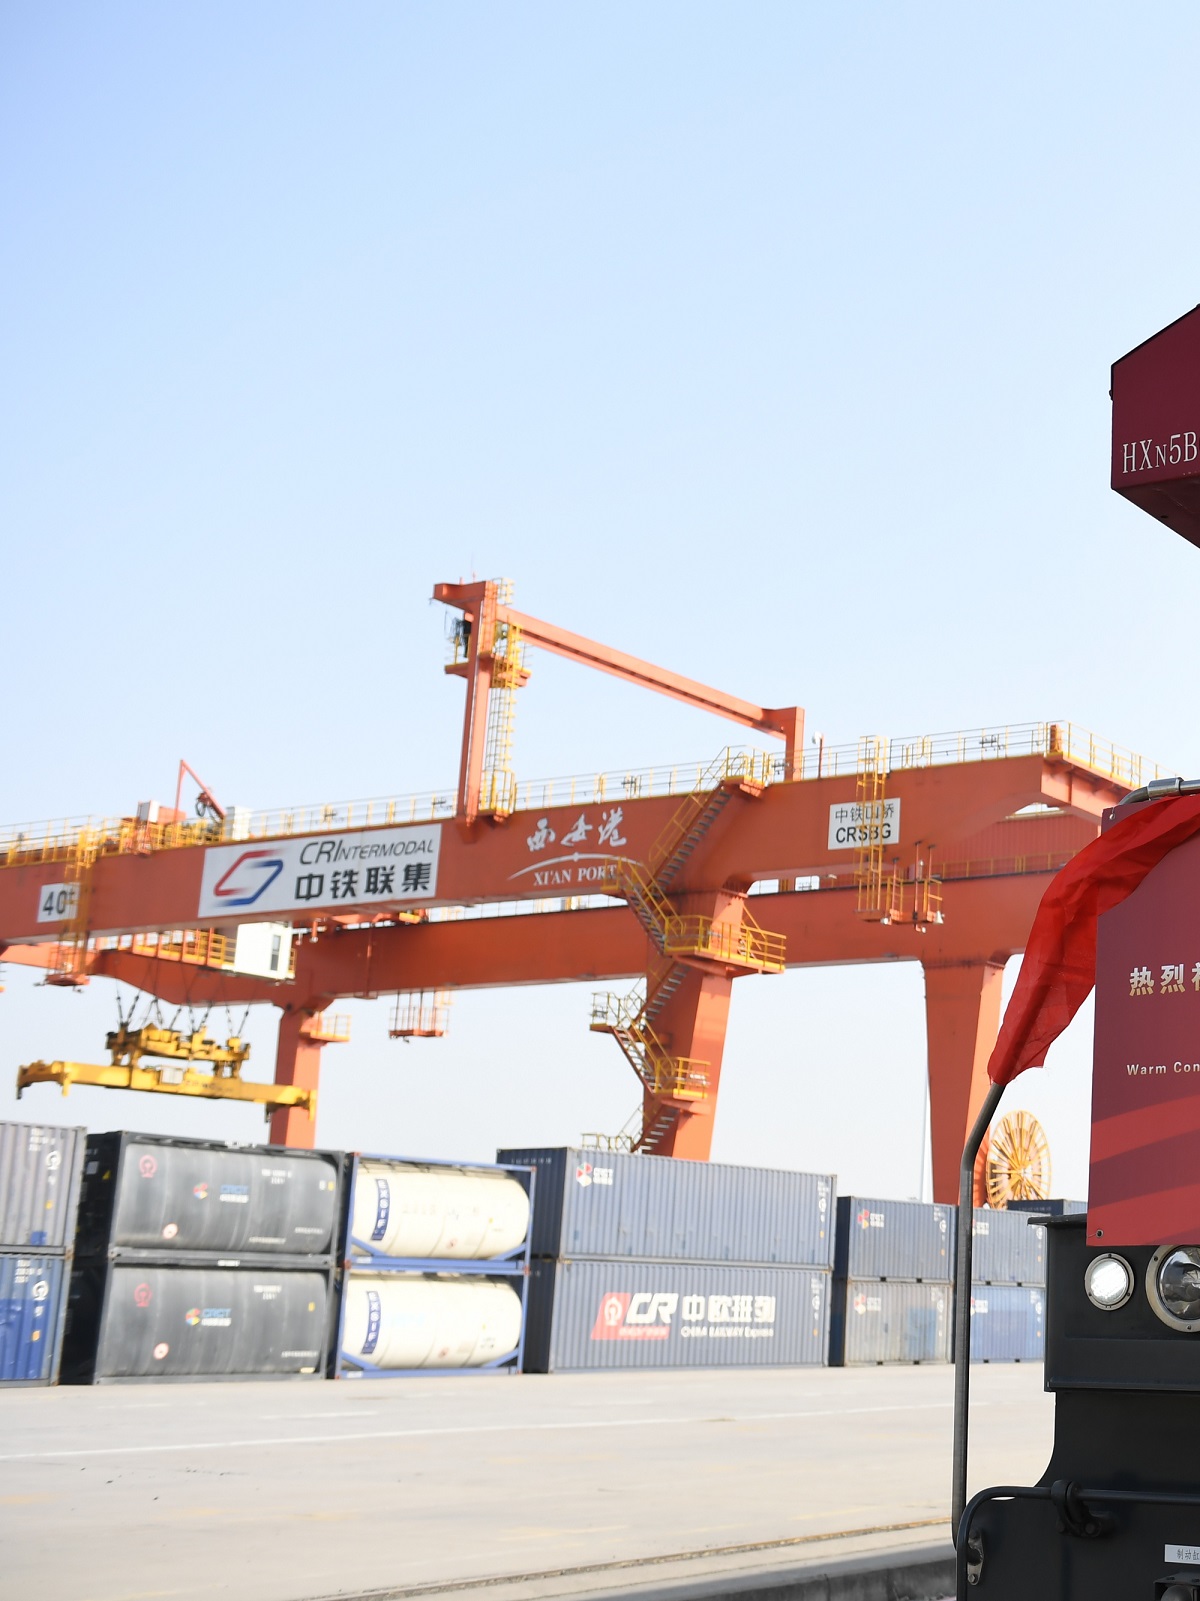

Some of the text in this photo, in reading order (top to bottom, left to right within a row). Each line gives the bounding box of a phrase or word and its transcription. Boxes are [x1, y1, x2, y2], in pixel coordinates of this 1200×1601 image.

[526, 806, 628, 852] 西安港
[836, 823, 892, 843] CRSBG
[294, 862, 433, 901] 中铁联集
[533, 868, 573, 886] XI'AN
[1126, 1063, 1167, 1076] Warm
[626, 1292, 680, 1324] CR
[681, 1294, 777, 1324] 中欧班列
